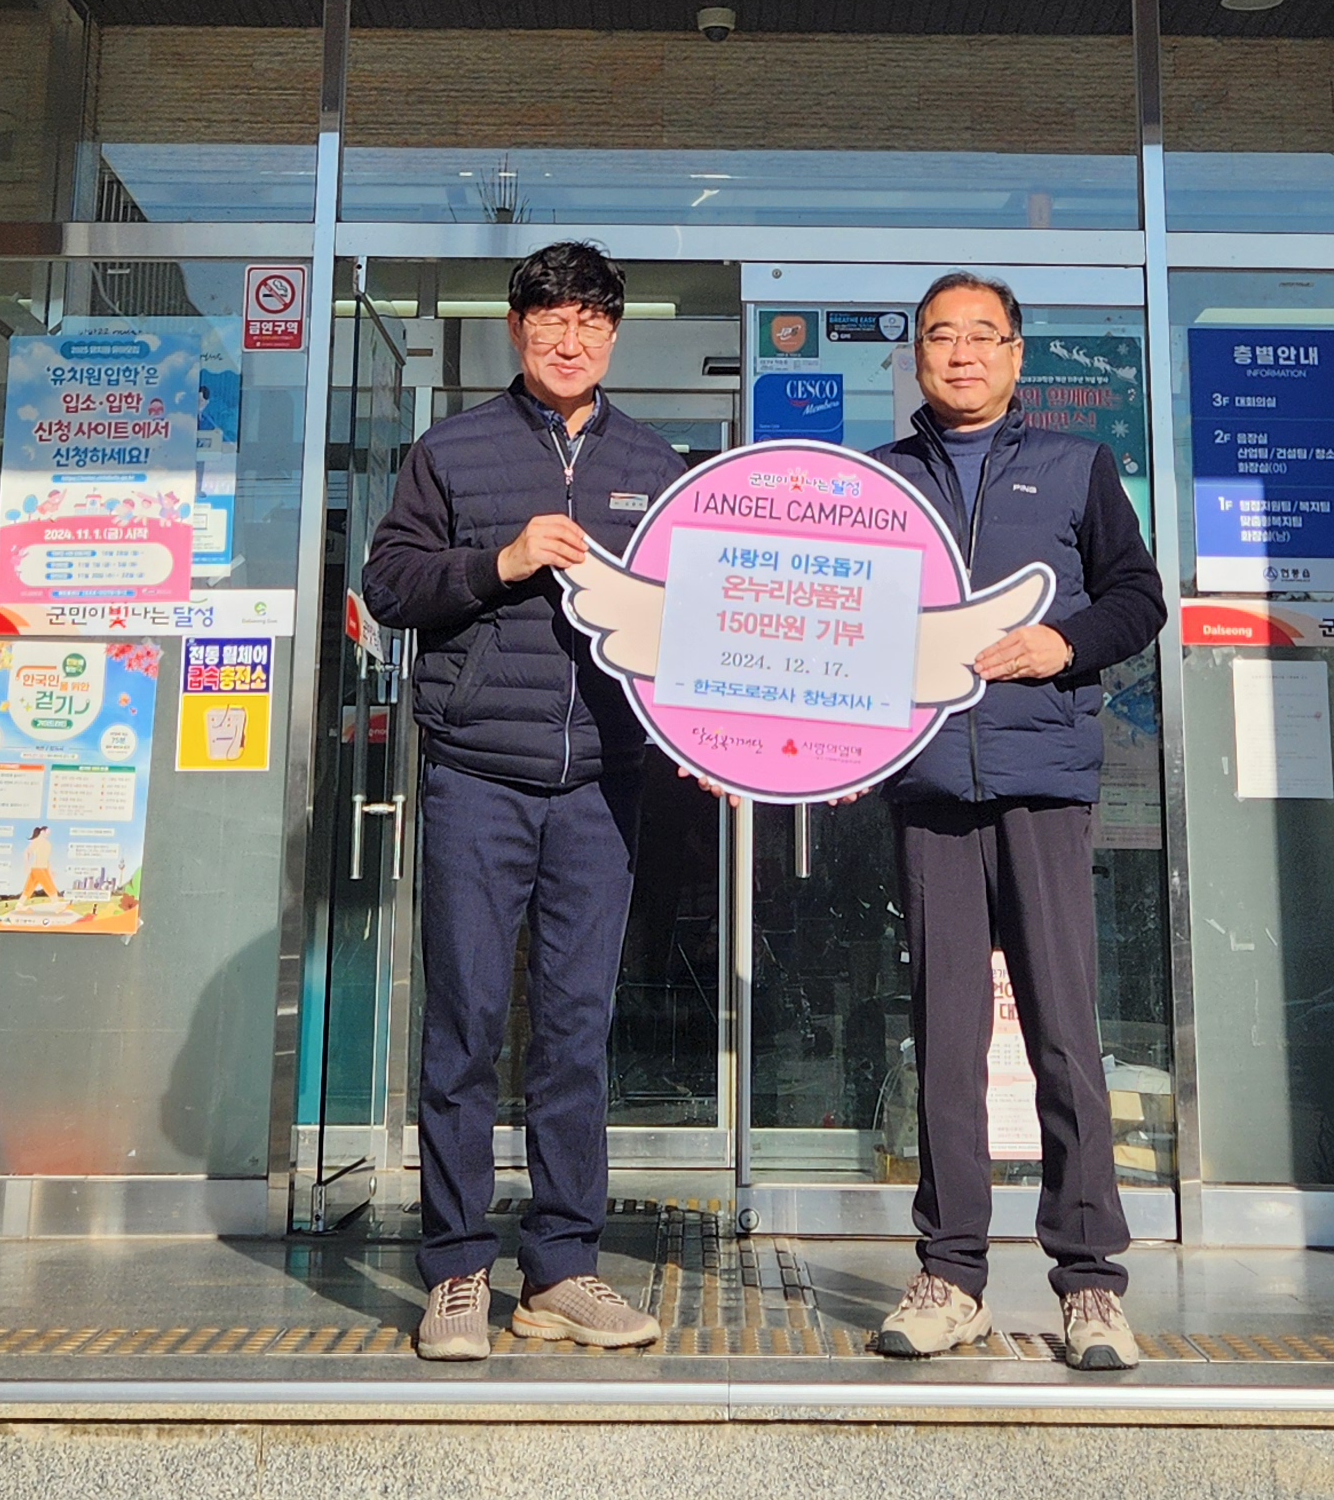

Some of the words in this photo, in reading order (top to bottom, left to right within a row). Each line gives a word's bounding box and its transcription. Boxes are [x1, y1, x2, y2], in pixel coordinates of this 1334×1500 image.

[248, 321, 299, 335] 금연구역
[1232, 344, 1319, 366] 층별안내
[1246, 368, 1308, 378] INFORMATION
[785, 379, 839, 400] CESCO
[1047, 385, 1124, 409] 함께하는
[1212, 393, 1230, 407] 3F
[1234, 396, 1277, 408] 대회의실
[802, 399, 841, 417] Members
[1213, 429, 1232, 444] 2F
[51, 446, 151, 468] 신청하세요!
[748, 472, 788, 489] 군민이
[789, 473, 829, 492] 빛나는
[831, 478, 862, 497] 달성
[702, 492, 783, 521] ANGEL
[786, 500, 908, 533] CAMPAIGN
[1217, 496, 1234, 512] 1F
[124, 527, 149, 540] 시작
[717, 547, 780, 571] 사랑의
[790, 553, 873, 581] 이웃돕기
[721, 573, 864, 612] 온누리상품권
[45, 606, 106, 626] 군민이
[108, 604, 170, 629] 빛나는
[173, 606, 215, 629] 달성
[715, 609, 807, 642] 150만원
[815, 618, 866, 647] 기부
[1202, 623, 1254, 640] Dalseong
[188, 644, 220, 665] 전동
[222, 644, 268, 665] 휠체어
[720, 651, 772, 671] 2024.
[783, 657, 811, 675] 12.
[823, 661, 850, 678] 17.
[187, 664, 267, 691] 급속충전소
[35, 690, 74, 716] 걷기
[693, 678, 797, 703] 한국도로공사
[803, 689, 873, 711] 창녕지사
